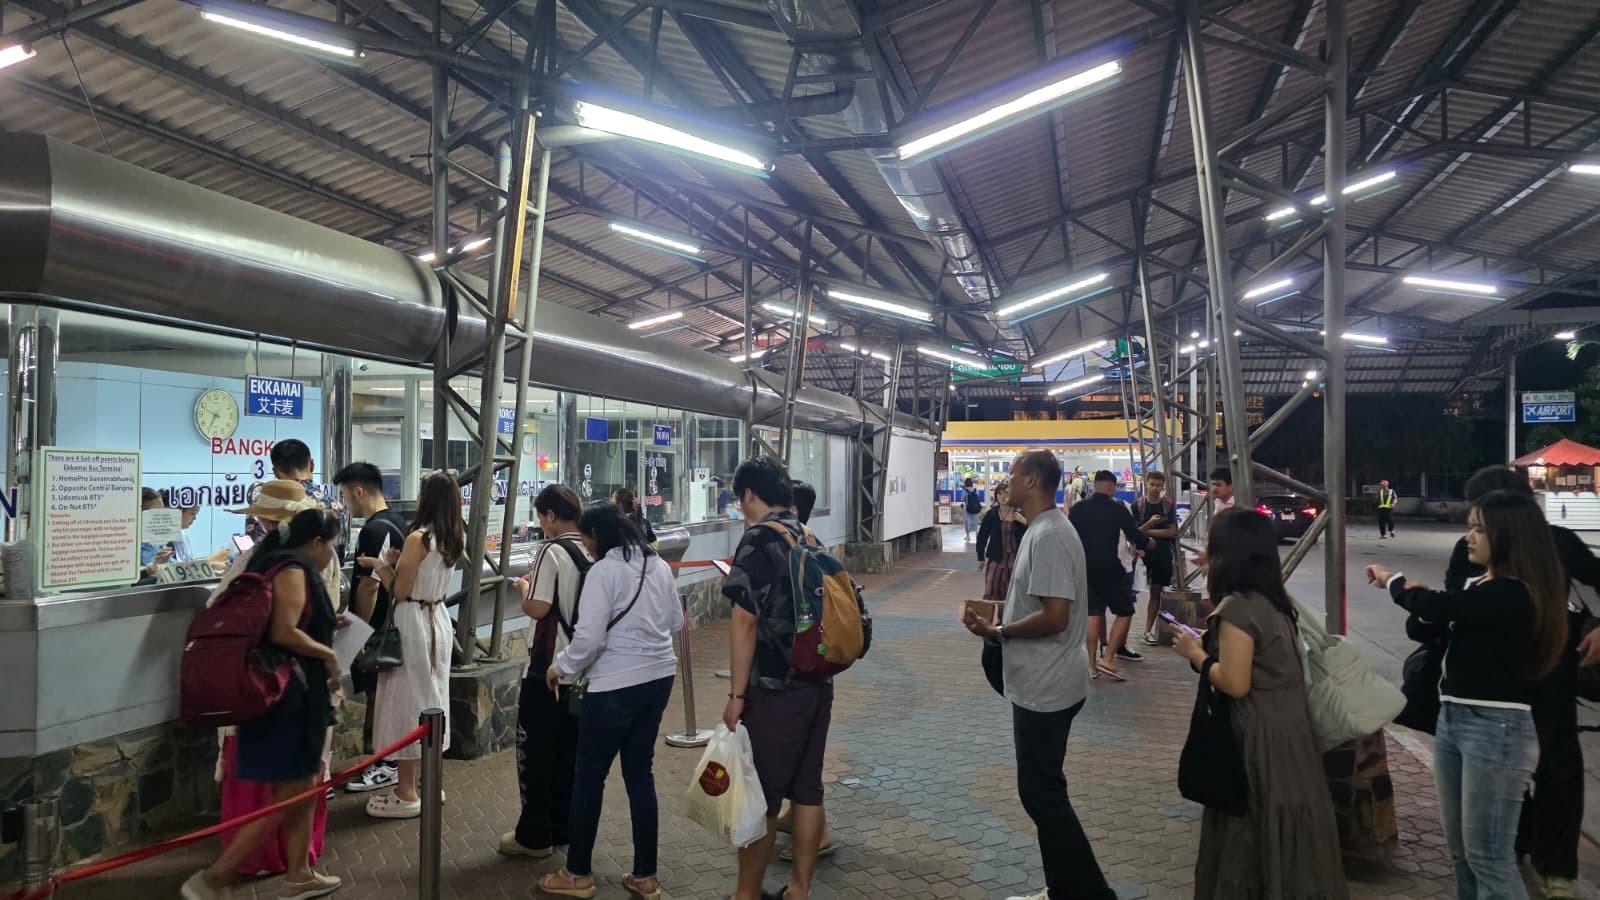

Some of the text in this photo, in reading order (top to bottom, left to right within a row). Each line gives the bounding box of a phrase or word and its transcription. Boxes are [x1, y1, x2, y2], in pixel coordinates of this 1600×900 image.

[250, 379, 301, 397] EKKAMAI
[257, 396, 294, 416] 艾卡麦
[1537, 405, 1572, 416] AIRPORT
[211, 437, 274, 456] BANGK
[254, 460, 265, 479] 3
[59, 484, 88, 493] Opposite
[169, 473, 245, 508] เอกมัย
